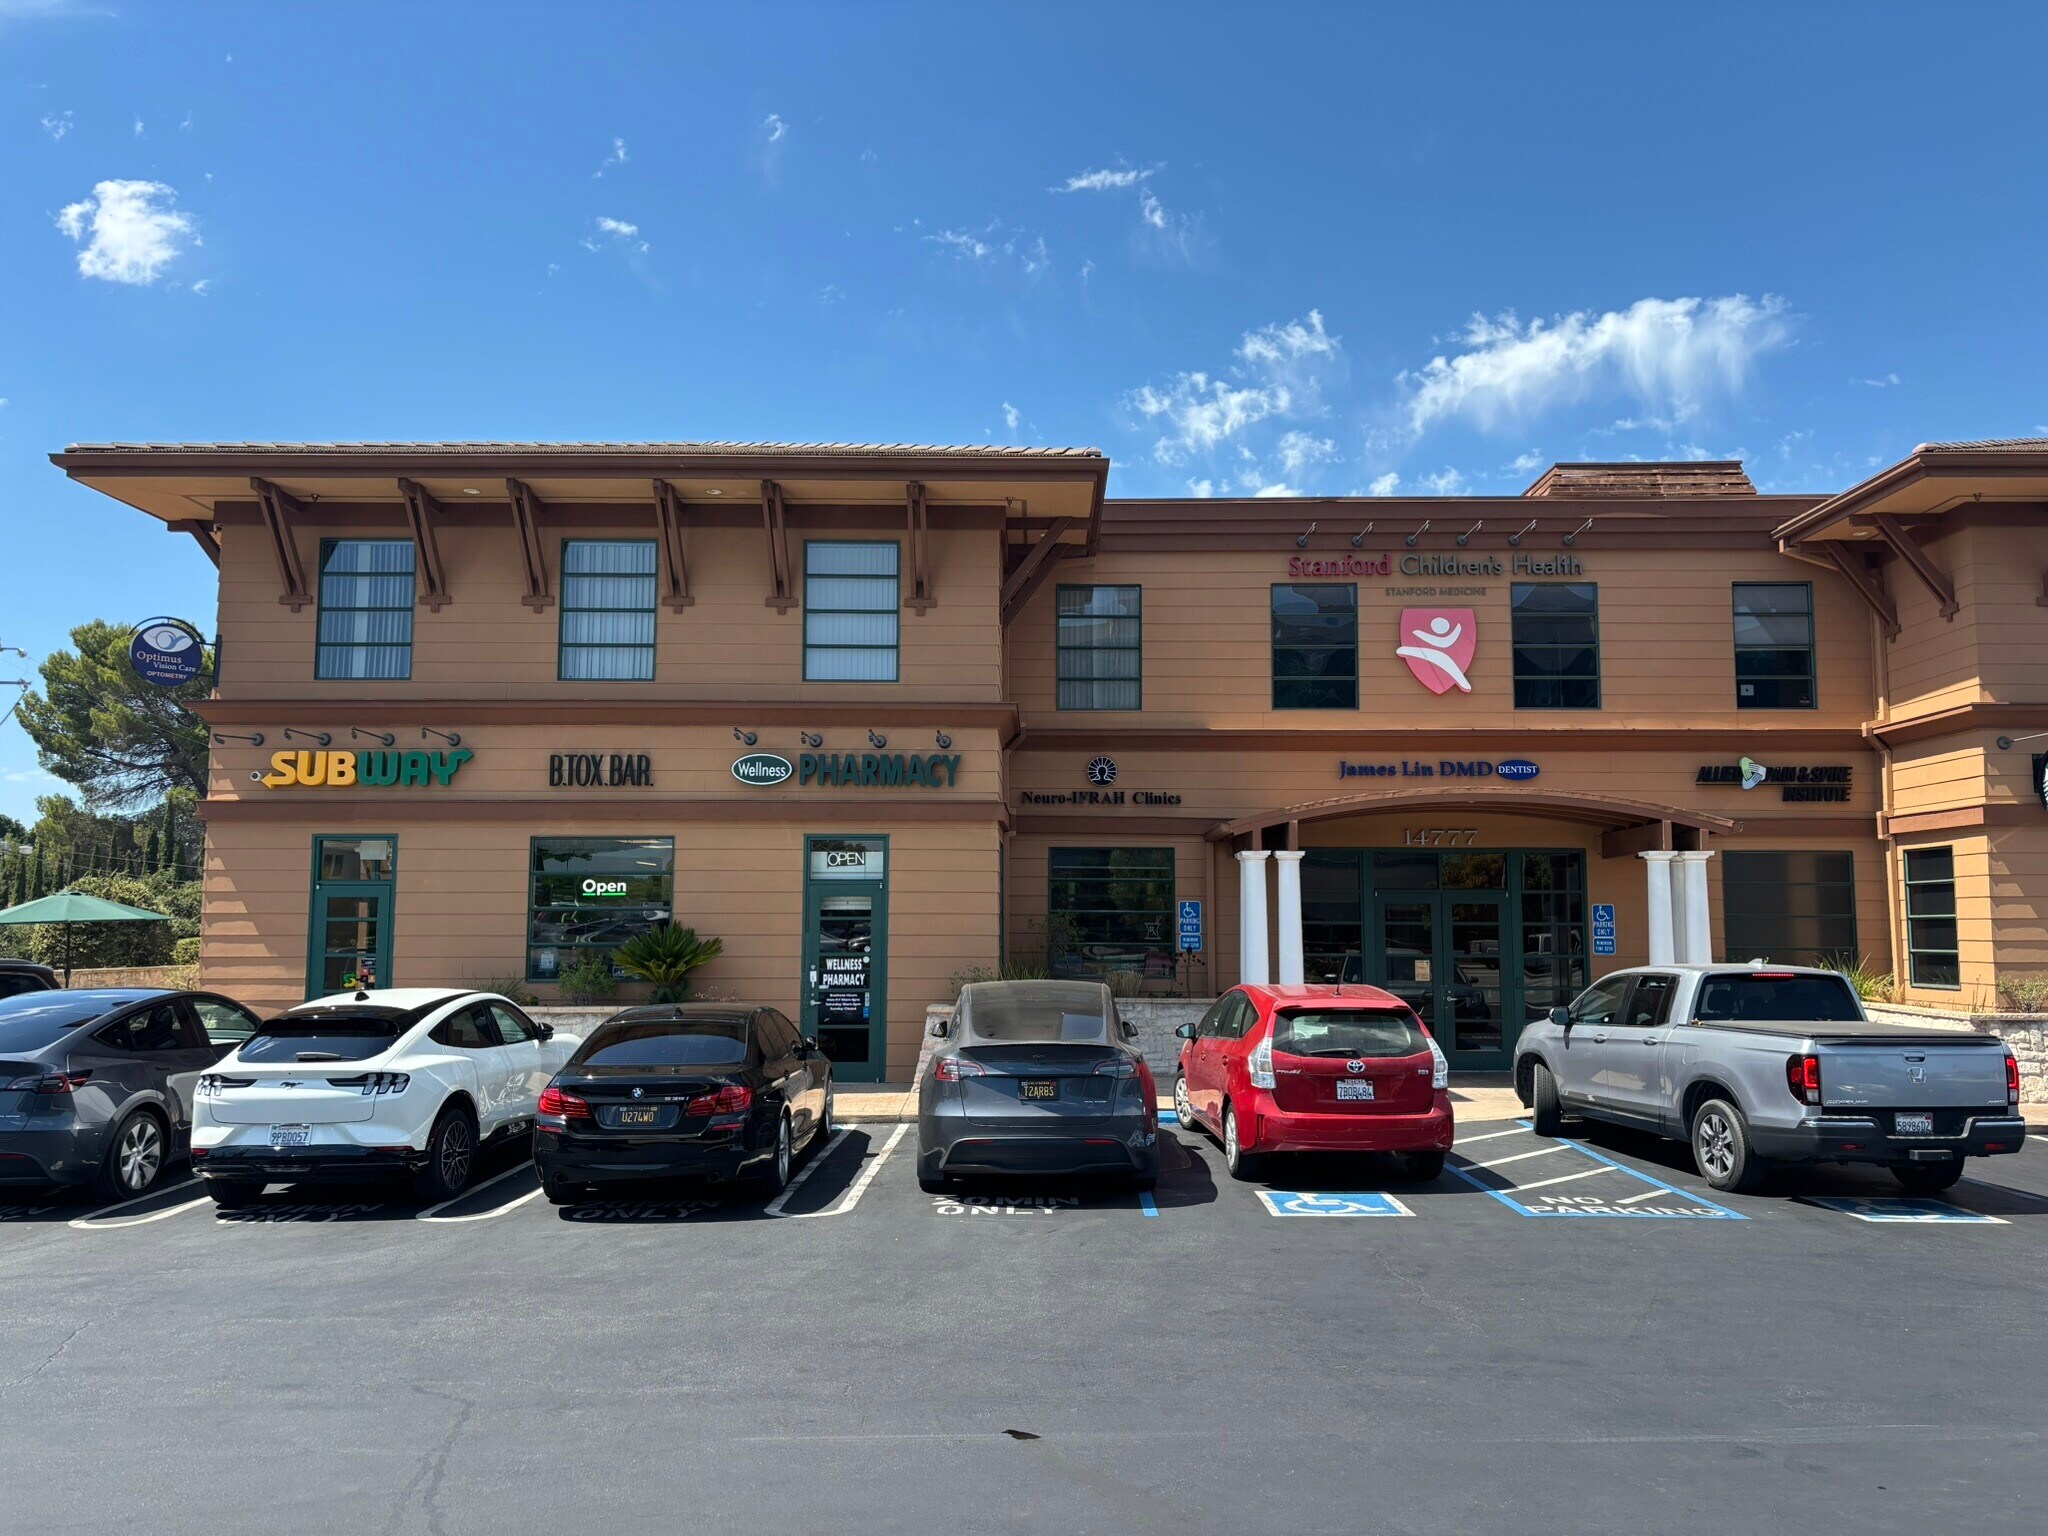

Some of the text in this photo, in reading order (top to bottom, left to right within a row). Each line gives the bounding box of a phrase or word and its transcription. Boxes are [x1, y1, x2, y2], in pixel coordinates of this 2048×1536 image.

[1288, 553, 1584, 577] Stanford Children's Health
[1385, 587, 1487, 597] STANFORD MEDICINE
[136, 650, 182, 664] Optimus
[153, 661, 197, 673] Vision Care
[146, 670, 188, 680] OPTOMETRY
[261, 747, 474, 789] SUBWAY
[737, 761, 787, 778] Wellness
[799, 753, 962, 788] PHARMACY
[1338, 760, 1538, 780] James Lin DMD DENTIST
[1810, 766, 1853, 783] SPINE
[1021, 790, 1182, 805] Neuro-IFRAH Clinics
[1782, 786, 1852, 802] INSTITUTE
[1404, 829, 1479, 846] 14777
[827, 851, 865, 866] OPEN
[582, 878, 627, 897] Open
[1180, 917, 1201, 925] PARKING
[1593, 920, 1614, 928] PARKING
[1183, 924, 1197, 932] ONLY
[1597, 928, 1611, 936] ONLY
[826, 958, 863, 971] WELLNESS
[822, 973, 866, 986] PHARMACY
[995, 1196, 1080, 1205] MIN
[1538, 1196, 1605, 1205] NO
[572, 1208, 704, 1219] ONLY
[936, 1205, 1061, 1215] ONLY
[1523, 1205, 1726, 1216] PARKING
